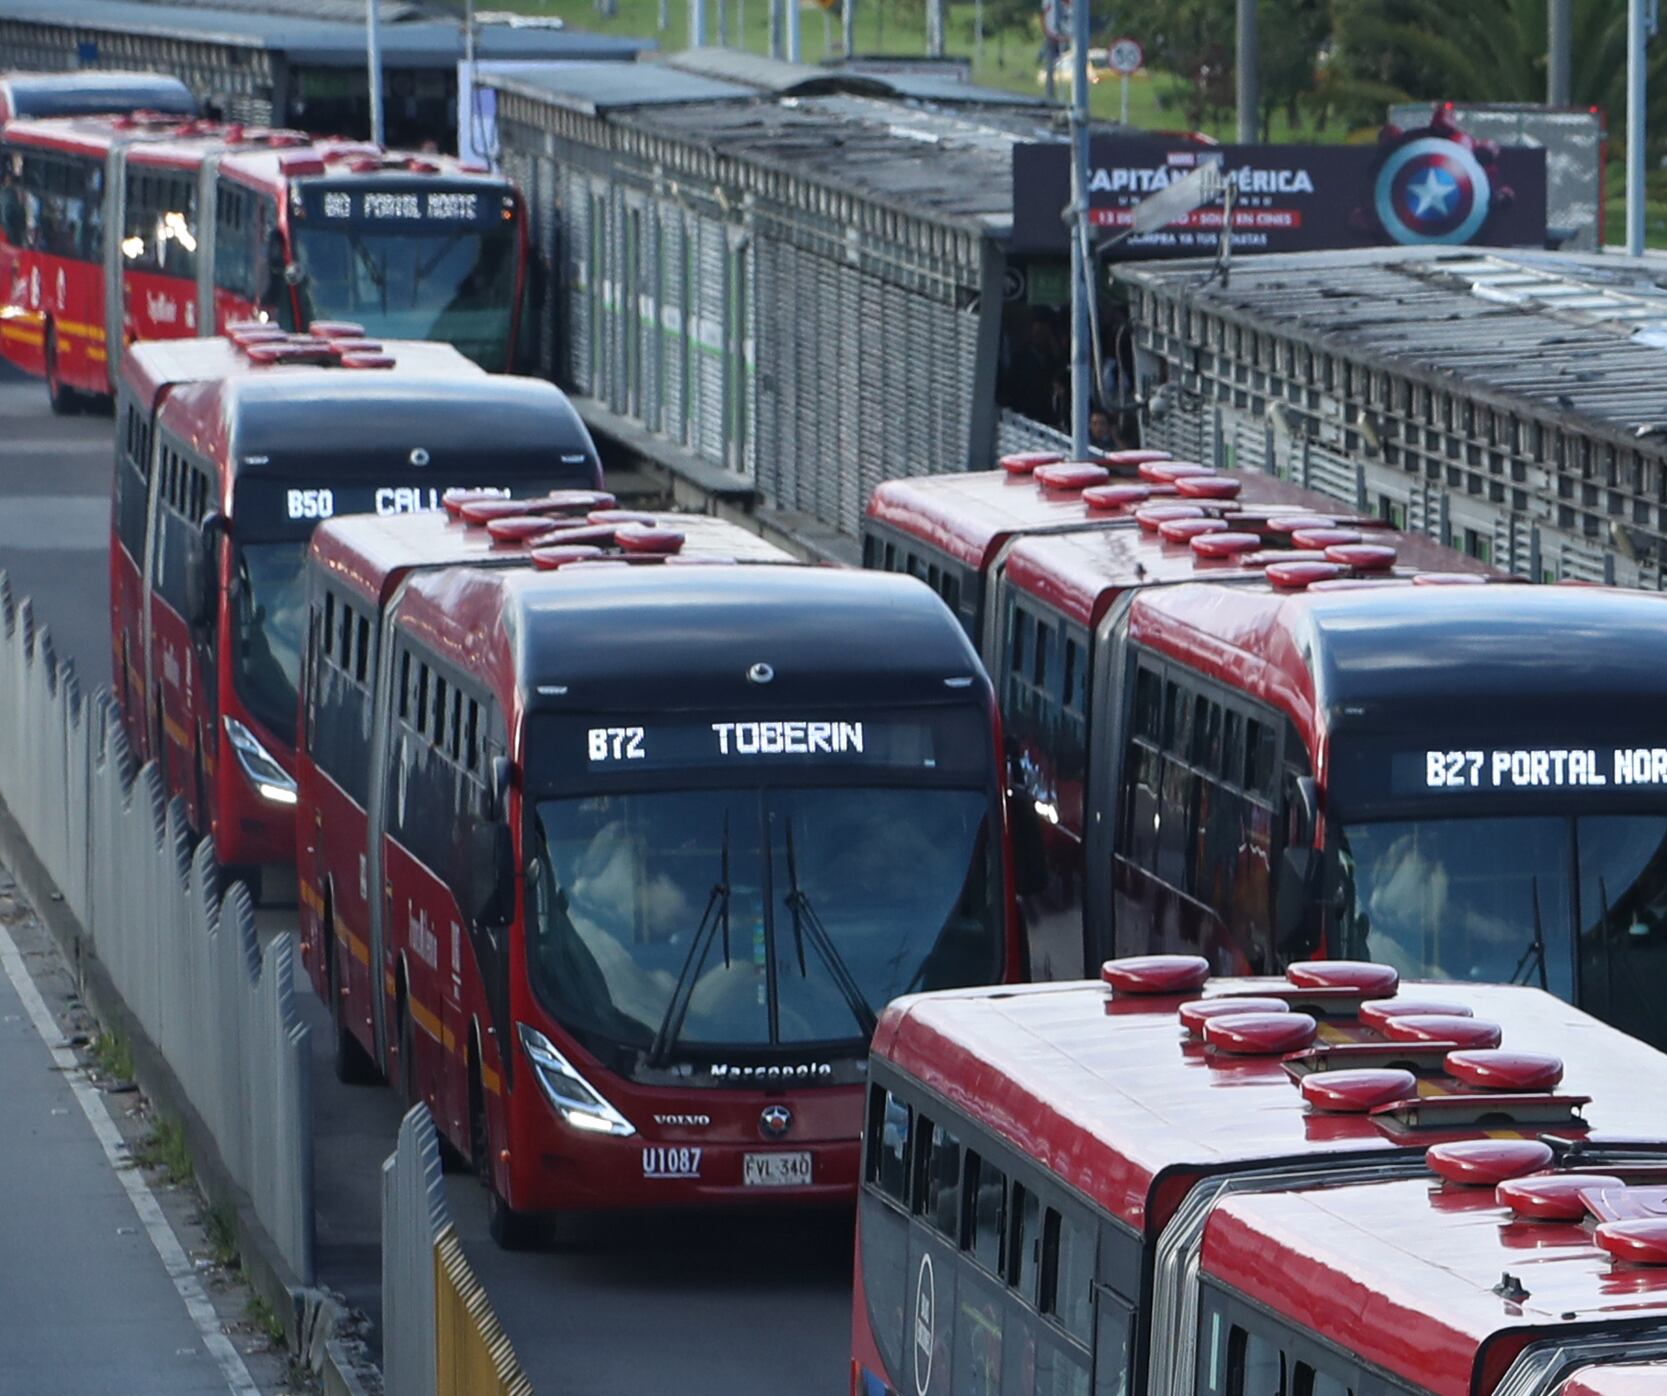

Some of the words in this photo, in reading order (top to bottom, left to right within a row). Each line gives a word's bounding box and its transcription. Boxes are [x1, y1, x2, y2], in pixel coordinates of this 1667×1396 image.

[1088, 165, 1188, 193] APITÁN
[287, 488, 333, 519] B50
[588, 727, 645, 761] B72
[712, 721, 864, 754] TOBERIN
[1426, 750, 1485, 786] B27
[1491, 750, 1607, 786] PORTAL
[710, 1062, 832, 1080] Marcopolo
[652, 1113, 711, 1126] VOLVO
[642, 1147, 702, 1173] U1087
